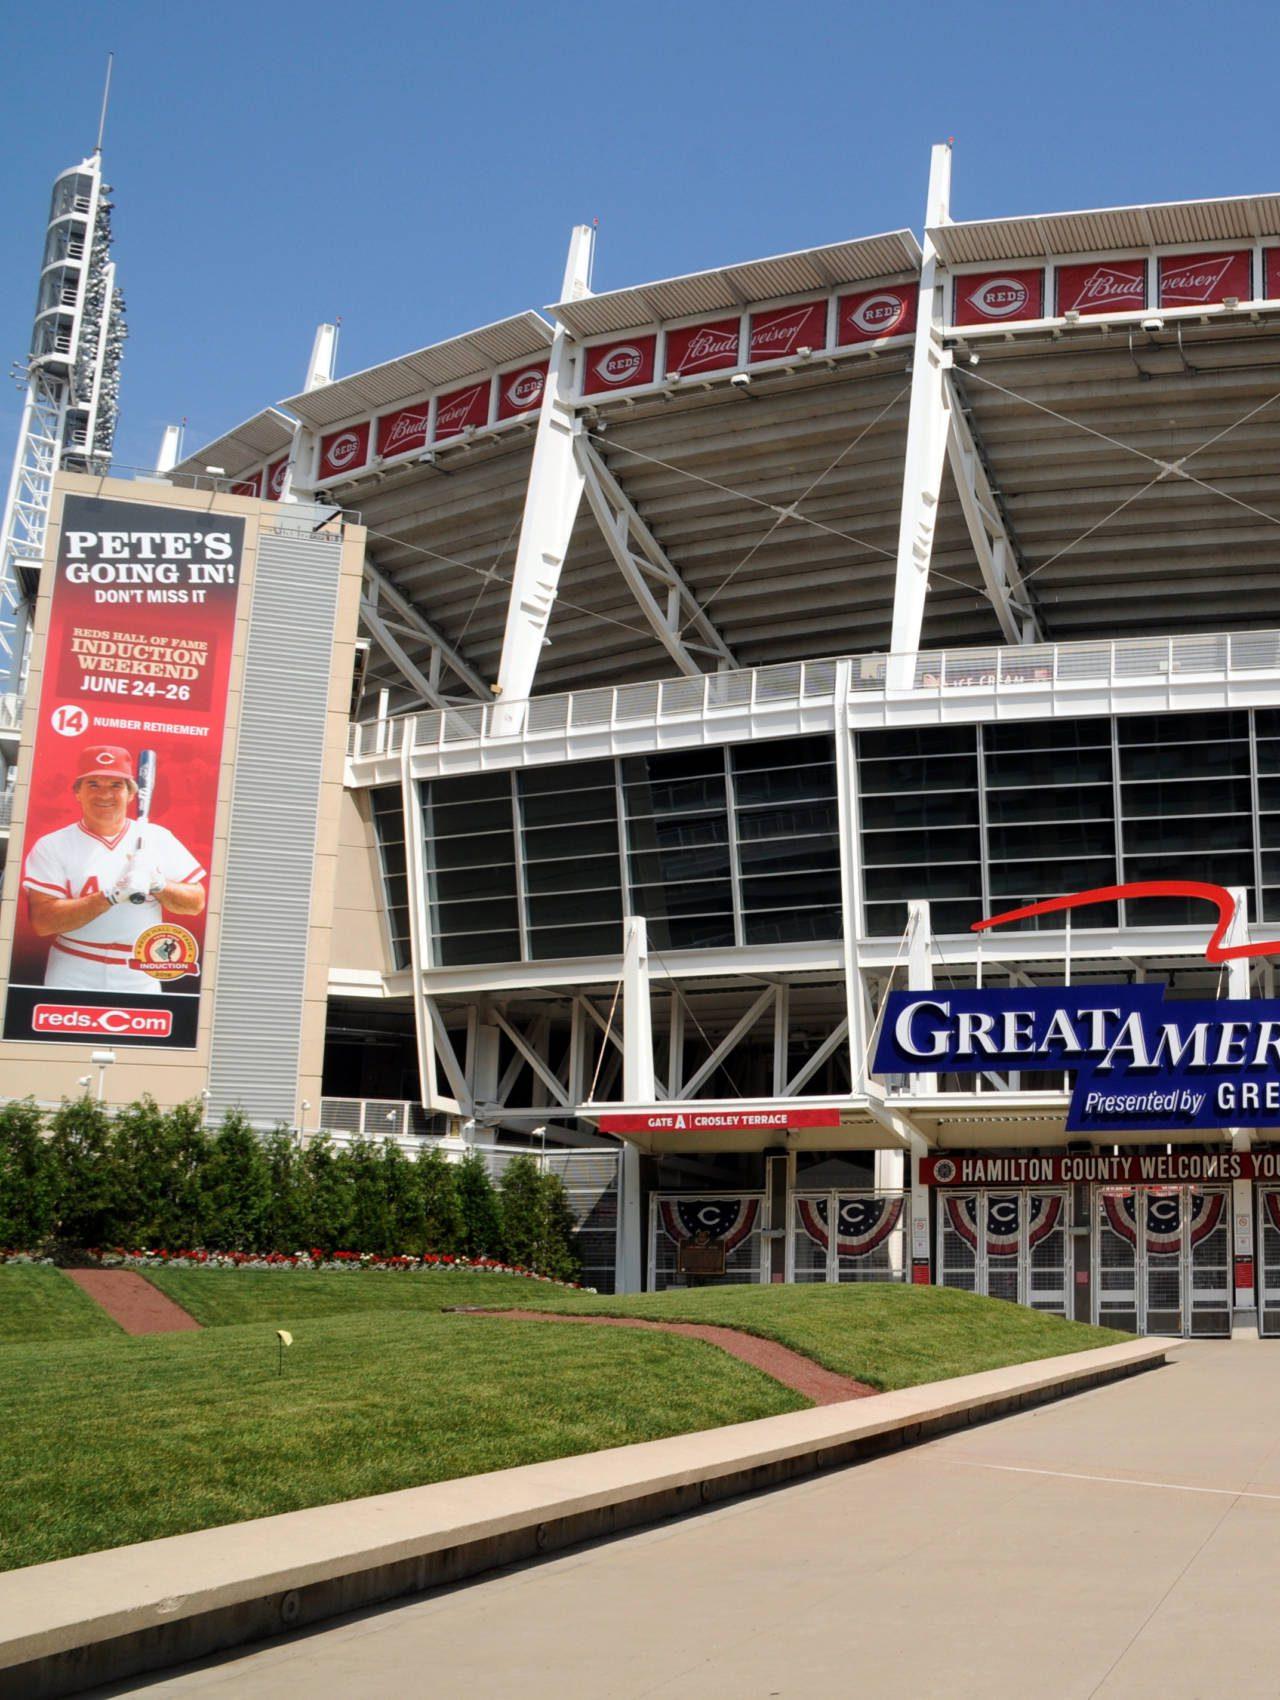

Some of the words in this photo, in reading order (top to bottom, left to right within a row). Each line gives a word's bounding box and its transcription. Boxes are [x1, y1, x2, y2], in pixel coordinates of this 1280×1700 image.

[1085, 273, 1220, 297] Budweiser
[986, 289, 1026, 304] REDS
[865, 304, 901, 321] REDS
[688, 325, 801, 359] Budweiser
[607, 355, 641, 373] REDS
[516, 378, 544, 396] REDS
[392, 403, 471, 442] Budweiser
[334, 440, 359, 458] REDS
[65, 531, 233, 560] PETE'S
[65, 563, 180, 584] GOING
[188, 564, 236, 585] IN!
[95, 589, 144, 604] DON'T
[147, 589, 189, 604] MISS
[192, 589, 206, 604] IT
[73, 628, 110, 640] REDS
[113, 632, 147, 644] HALL
[150, 636, 169, 646] OF
[171, 639, 208, 650] FAME
[70, 638, 209, 666] INDUCTION
[77, 654, 199, 681] WEEKEND
[80, 675, 130, 695] JUNE
[57, 709, 83, 732] 14
[93, 717, 142, 731] NUMBER
[143, 722, 210, 737] RETIREMENT
[895, 1000, 1121, 1057] GREAT
[1086, 1090, 1179, 1114] Presented
[1180, 1089, 1207, 1115] by
[647, 1117, 673, 1128] GATE
[674, 1114, 686, 1129] A
[694, 1115, 739, 1127] CROSLEY
[741, 1114, 788, 1125] TERRACE
[962, 1158, 1053, 1182] HAMILTON
[1061, 1156, 1132, 1181] COUNTY
[1140, 1155, 1241, 1180] WELCOMES
